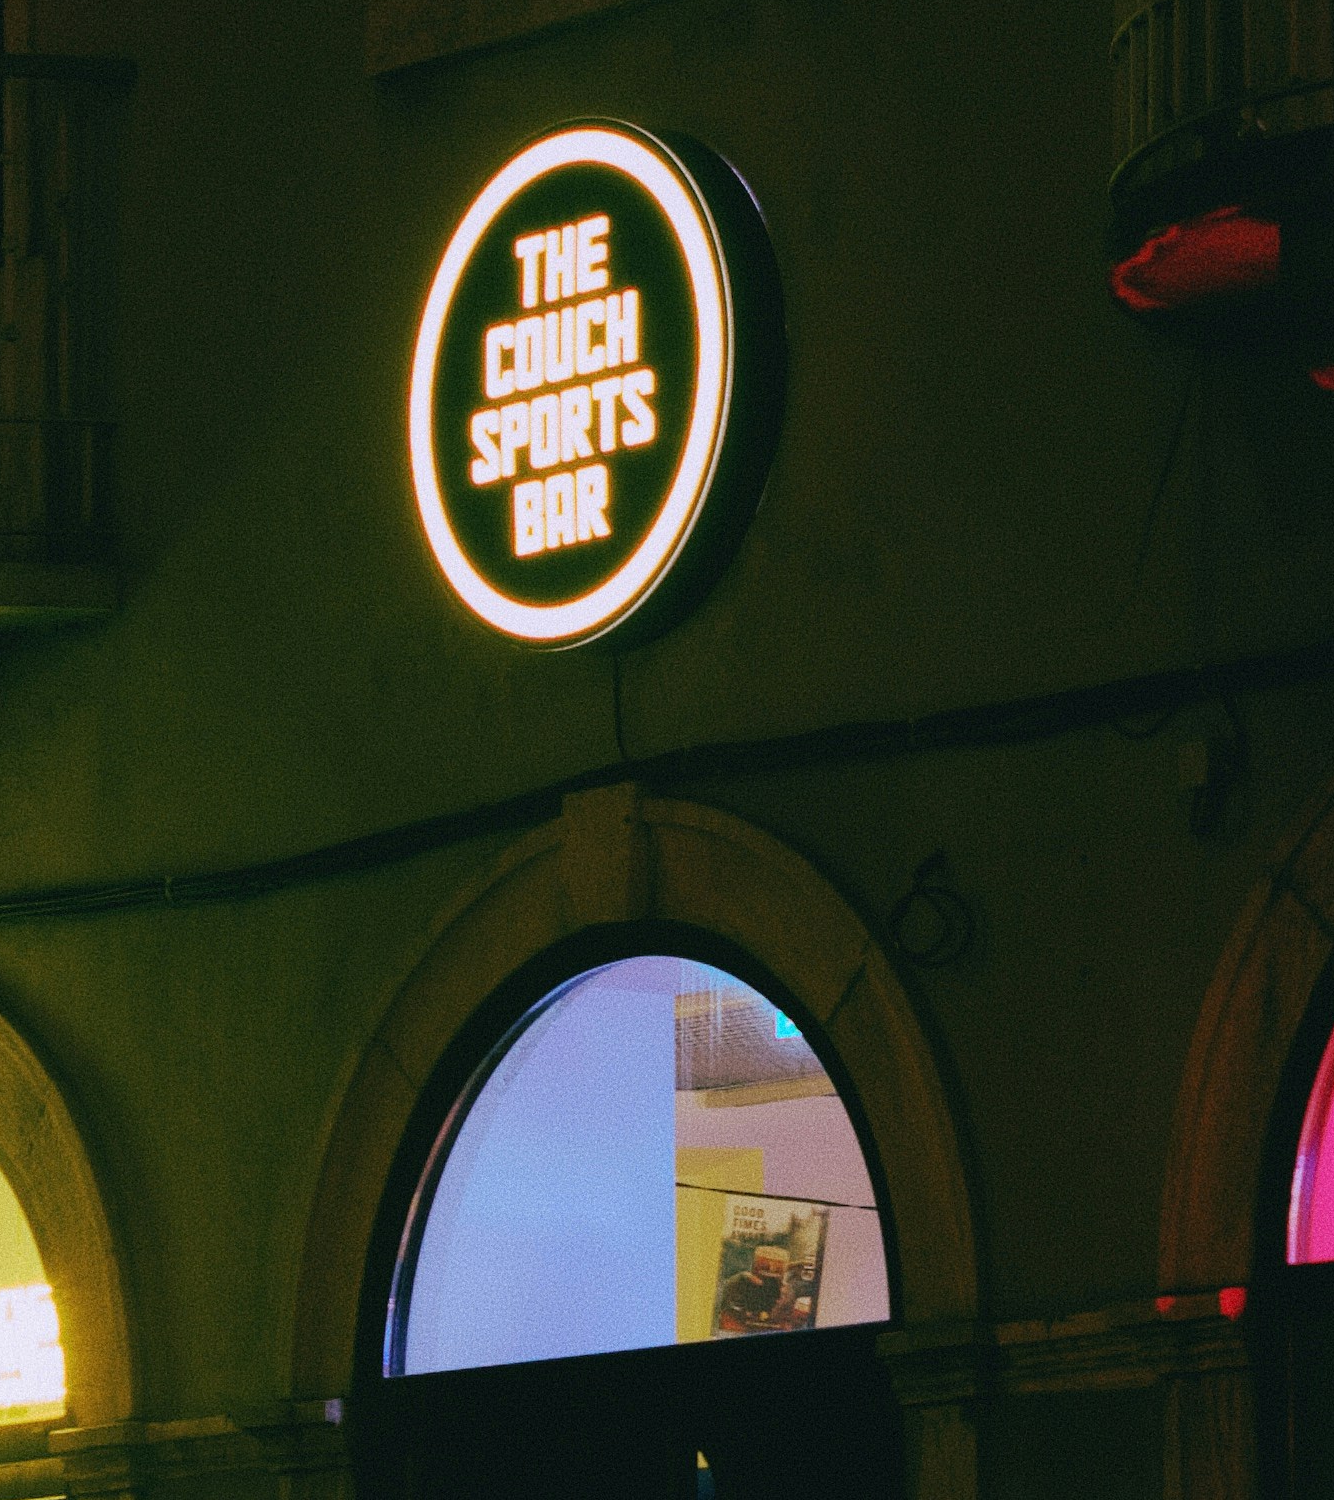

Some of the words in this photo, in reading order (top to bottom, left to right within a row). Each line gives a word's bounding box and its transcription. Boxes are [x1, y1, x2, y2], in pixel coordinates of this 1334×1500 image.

[515, 214, 610, 309] THE
[484, 289, 639, 400] COUCH
[470, 368, 655, 486] SPORTS
[512, 463, 612, 559] BAR
